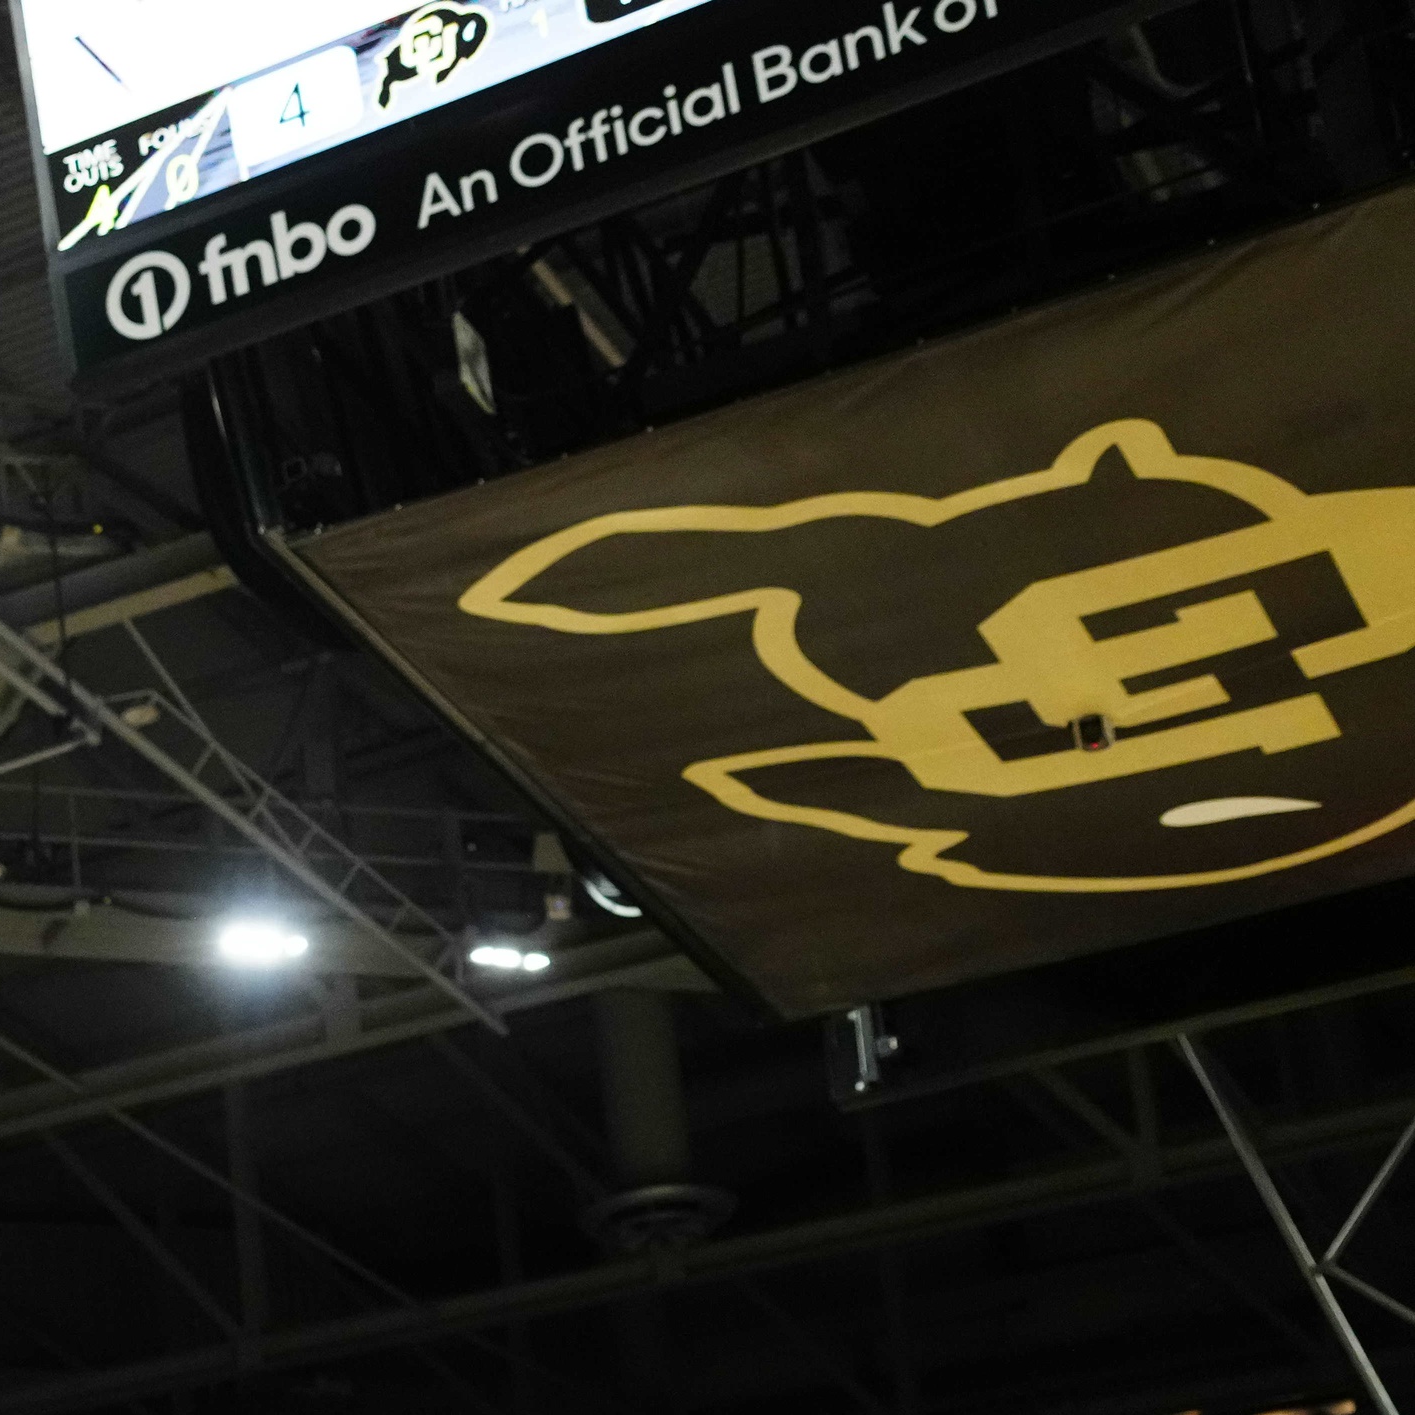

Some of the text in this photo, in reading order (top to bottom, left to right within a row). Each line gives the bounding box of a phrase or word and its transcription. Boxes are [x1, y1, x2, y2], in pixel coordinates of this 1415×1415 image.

[63, 139, 118, 173] TIME
[198, 204, 376, 305] fnbo
[417, 171, 497, 229] An
[510, 62, 741, 189] Official
[752, 1, 927, 103] Bank
[64, 156, 124, 193] OUTS
